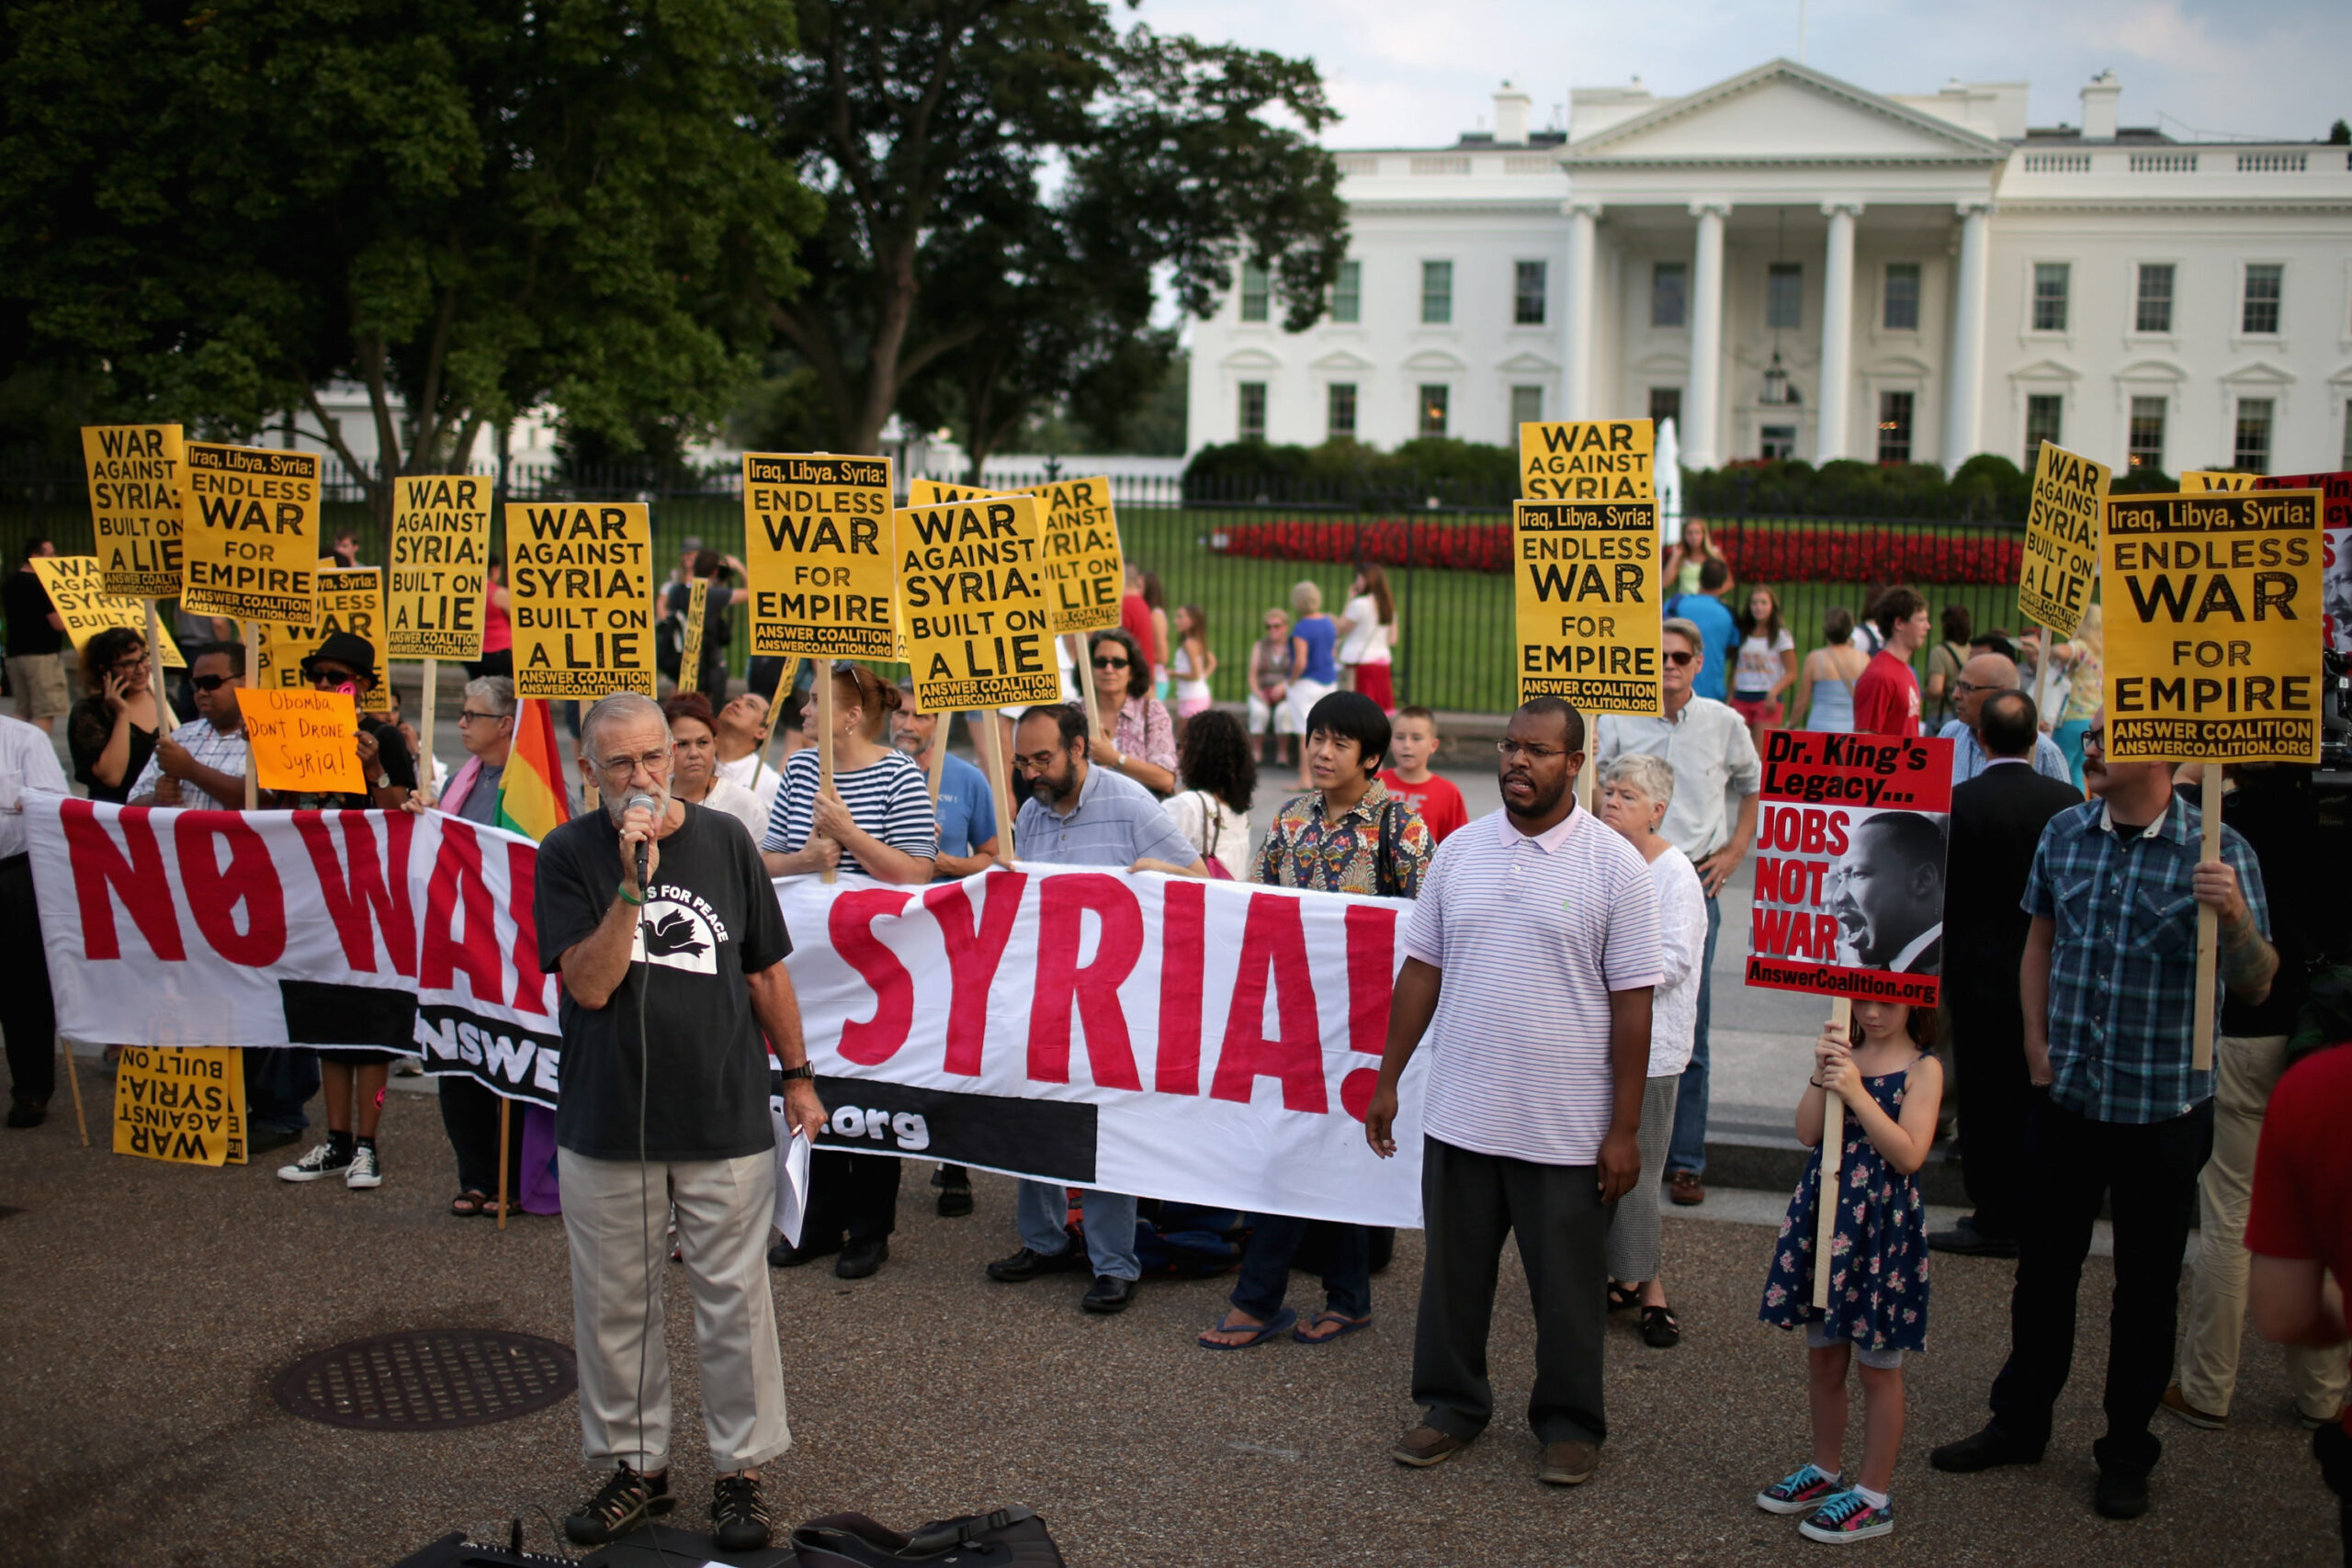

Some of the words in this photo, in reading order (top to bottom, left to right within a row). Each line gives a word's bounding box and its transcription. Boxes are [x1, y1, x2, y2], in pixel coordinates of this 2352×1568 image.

[98, 429, 164, 458] WAR
[1542, 423, 1632, 452] WAR
[93, 460, 176, 479] AGAINST
[190, 449, 222, 469] Iraq,
[226, 452, 266, 473] Libya,
[271, 457, 312, 477] Syria:
[750, 459, 786, 482] Iraq,
[789, 461, 837, 483] Libya,
[841, 463, 885, 485] Syria:
[1529, 454, 1647, 475] AGAINST
[2049, 449, 2098, 495] WAR
[96, 483, 181, 509] SYRIA:
[192, 473, 311, 502] ENDLESS
[409, 480, 477, 509] WAR
[1529, 477, 1646, 499] SYRIA:
[2035, 478, 2098, 520] AGAINST
[2308, 474, 2352, 499] Kin
[198, 495, 304, 536] WAR
[754, 490, 885, 514] ENDLESS
[2110, 504, 2161, 530] Iraq,
[2168, 502, 2235, 531] Libya,
[2242, 500, 2311, 529] Syria:
[99, 517, 149, 536] BUILT
[156, 519, 183, 536] ON
[397, 513, 486, 533] AGAINST
[527, 508, 627, 540] WAR
[912, 503, 1018, 545] WAR
[1046, 507, 1107, 531] AINST
[1521, 508, 1553, 530] Iraq,
[1557, 507, 1602, 530] Libya,
[1607, 506, 1651, 528] Syria:
[2032, 500, 2098, 551] SYRIA:
[763, 514, 879, 555] WAR
[1044, 529, 1113, 558] RIA:
[1523, 537, 1651, 560] ENDLESS
[111, 547, 126, 570] A
[131, 540, 183, 571] LIE
[225, 541, 275, 562] FOR
[395, 536, 483, 564] SYRIA:
[514, 543, 643, 564] AGAINST
[903, 539, 1035, 572] AGAINST
[2028, 532, 2067, 566] BUILT
[2070, 555, 2093, 579] ON
[2115, 537, 2310, 570] ENDLESS
[48, 559, 100, 577] WA
[106, 573, 139, 584] ANSWER
[142, 574, 182, 584] COALITI
[190, 561, 311, 593] EMPIRE
[340, 575, 376, 589] Syria:
[795, 567, 851, 587] FOR
[1045, 560, 1080, 581] ILT
[1088, 558, 1118, 575] ON
[51, 578, 102, 592] AGAI
[394, 572, 445, 592] BUILT
[453, 574, 481, 593] ON
[516, 569, 645, 598] SYRIA:
[906, 568, 1041, 607] SYRIA:
[1058, 576, 1116, 610] LIE
[1531, 564, 1644, 603] WAR
[2025, 566, 2034, 590] A
[2041, 565, 2085, 612] LIE
[57, 592, 143, 610] SYRIA
[187, 589, 239, 605] ANSWER
[243, 595, 311, 612] COALITION
[319, 594, 376, 611] LESS
[757, 592, 889, 624] EMPIRE
[2125, 571, 2299, 623] WAR
[67, 613, 128, 628] BUILT
[133, 615, 147, 626] O
[187, 602, 311, 622] ANSWERCOALITION.ORG
[396, 605, 409, 629] A
[418, 596, 474, 630] LIE
[518, 607, 597, 629] BUILT
[607, 609, 647, 628] ON
[912, 612, 994, 638] BUILT
[1005, 610, 1046, 631] ON
[390, 632, 421, 643] ANSWER
[424, 632, 478, 645] COALITION
[757, 626, 814, 643] ANSWER
[818, 627, 891, 644] COALITION
[1562, 616, 1615, 637] FOR
[390, 644, 478, 655] ANSWERCOALITION.ORG
[528, 642, 551, 668] A
[565, 632, 640, 669] LIE
[757, 639, 891, 657] ANSWERCOALITION.ORG
[928, 653, 953, 680] A
[965, 635, 1043, 677] LIE
[1524, 645, 1654, 675] EMPIRE
[2173, 640, 2251, 668] FOR
[520, 671, 574, 683] ANSWER
[578, 672, 650, 684] COALITION
[521, 684, 650, 694] ANSWERCOALITIONORG
[921, 681, 978, 696] ANSWER
[980, 675, 1055, 694] COALITION
[1523, 680, 1579, 694] ANSWER
[1582, 682, 1656, 698] COALITION
[270, 691, 334, 712] Obomba,
[923, 689, 1056, 708] ANSWERCOALITION.ORG
[2116, 676, 2311, 713] EMPIRE
[299, 717, 345, 739] DRONE
[2114, 721, 2198, 739] ANSWER
[2202, 720, 2311, 740] COALITION
[1767, 732, 1812, 764] Dr.
[1823, 735, 1928, 775] King's
[2114, 739, 2311, 756] ANSWERCOALITION.ORG
[1764, 763, 1914, 807] Legacy...
[1757, 806, 1850, 856] JOBS
[1755, 856, 1829, 907] NOT
[662, 886, 692, 903] FOR
[693, 897, 729, 942] PEACE
[1752, 908, 1838, 961] WAR
[60, 798, 287, 968] NO
[830, 872, 1398, 1126] SYRIA!
[1748, 961, 1936, 1003] AnswerCoalition.org
[123, 1050, 149, 1068] ON
[155, 1055, 222, 1078] BUILT
[413, 1015, 560, 1093] NSWE
[121, 1075, 222, 1111] SYRIA:
[119, 1104, 222, 1133] AGAINST
[131, 1124, 208, 1160] WAR
